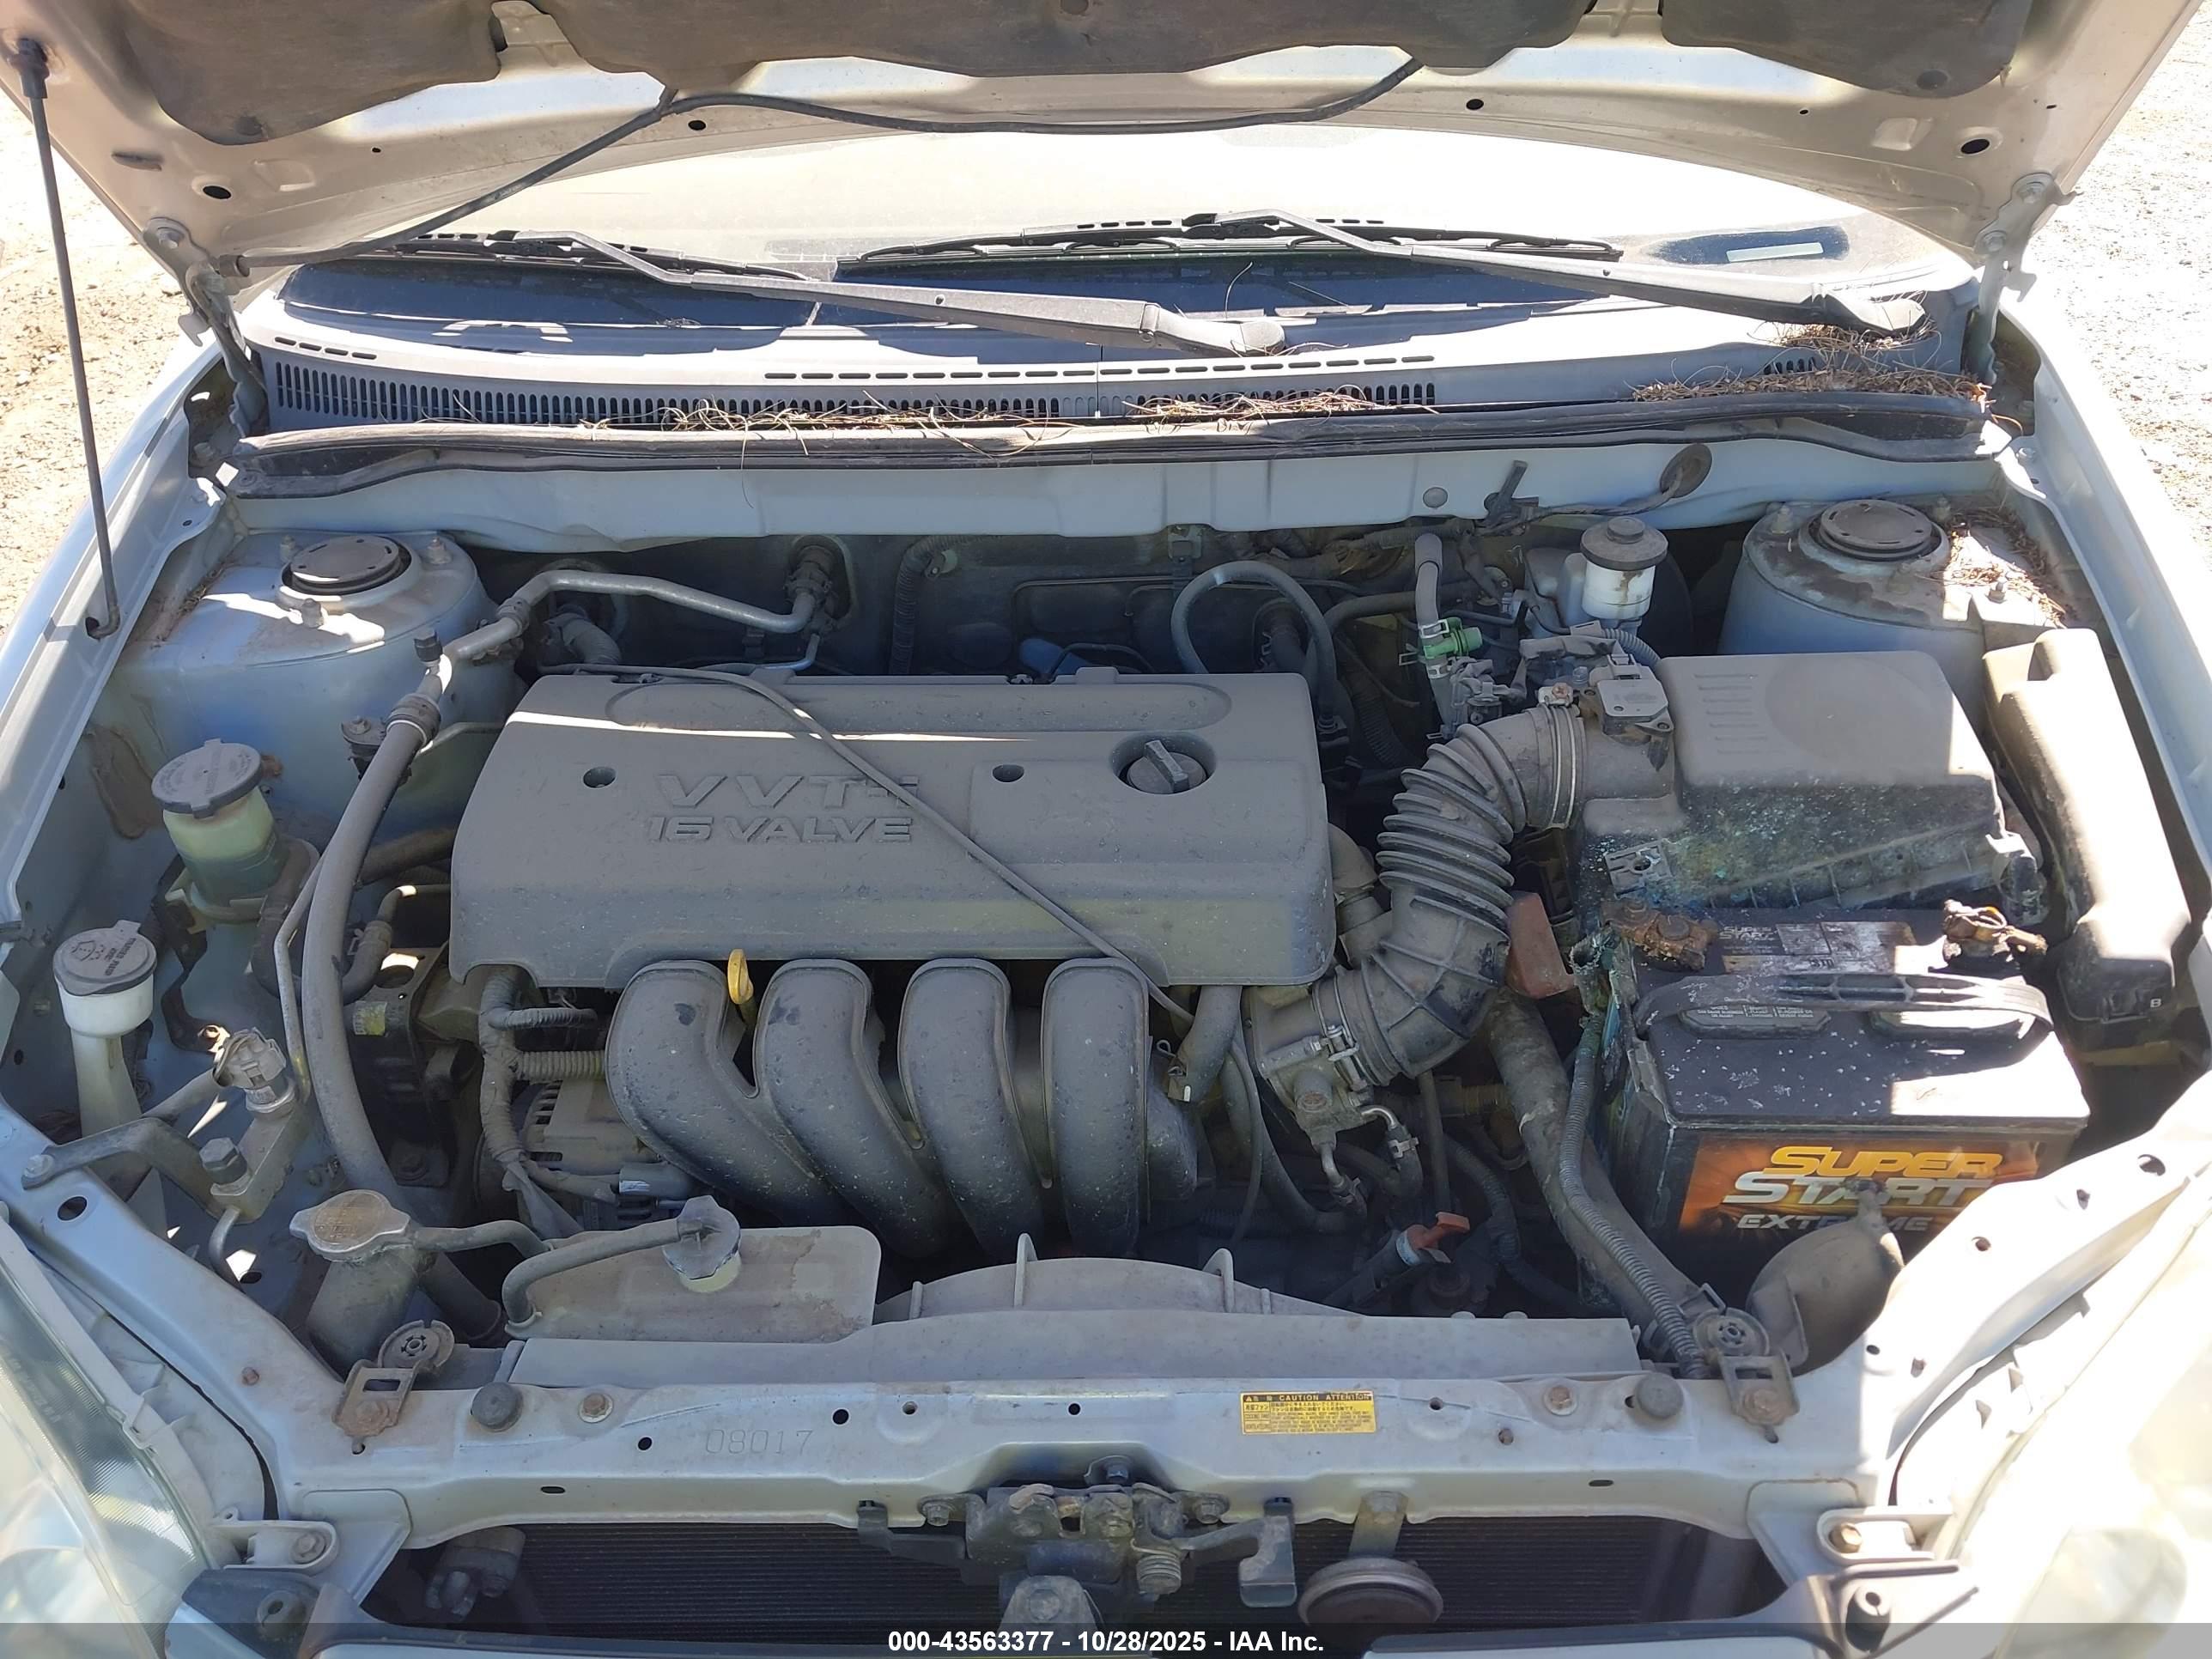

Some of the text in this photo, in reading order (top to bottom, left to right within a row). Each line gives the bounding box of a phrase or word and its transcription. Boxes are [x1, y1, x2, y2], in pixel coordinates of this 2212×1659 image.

[647, 817, 913, 842] 16 VALVE
[1761, 1146, 2003, 1177] SUPER
[1722, 1171, 1993, 1206] START
[1737, 1214, 1933, 1231] EXTRE
[706, 1429, 813, 1455] 08017
